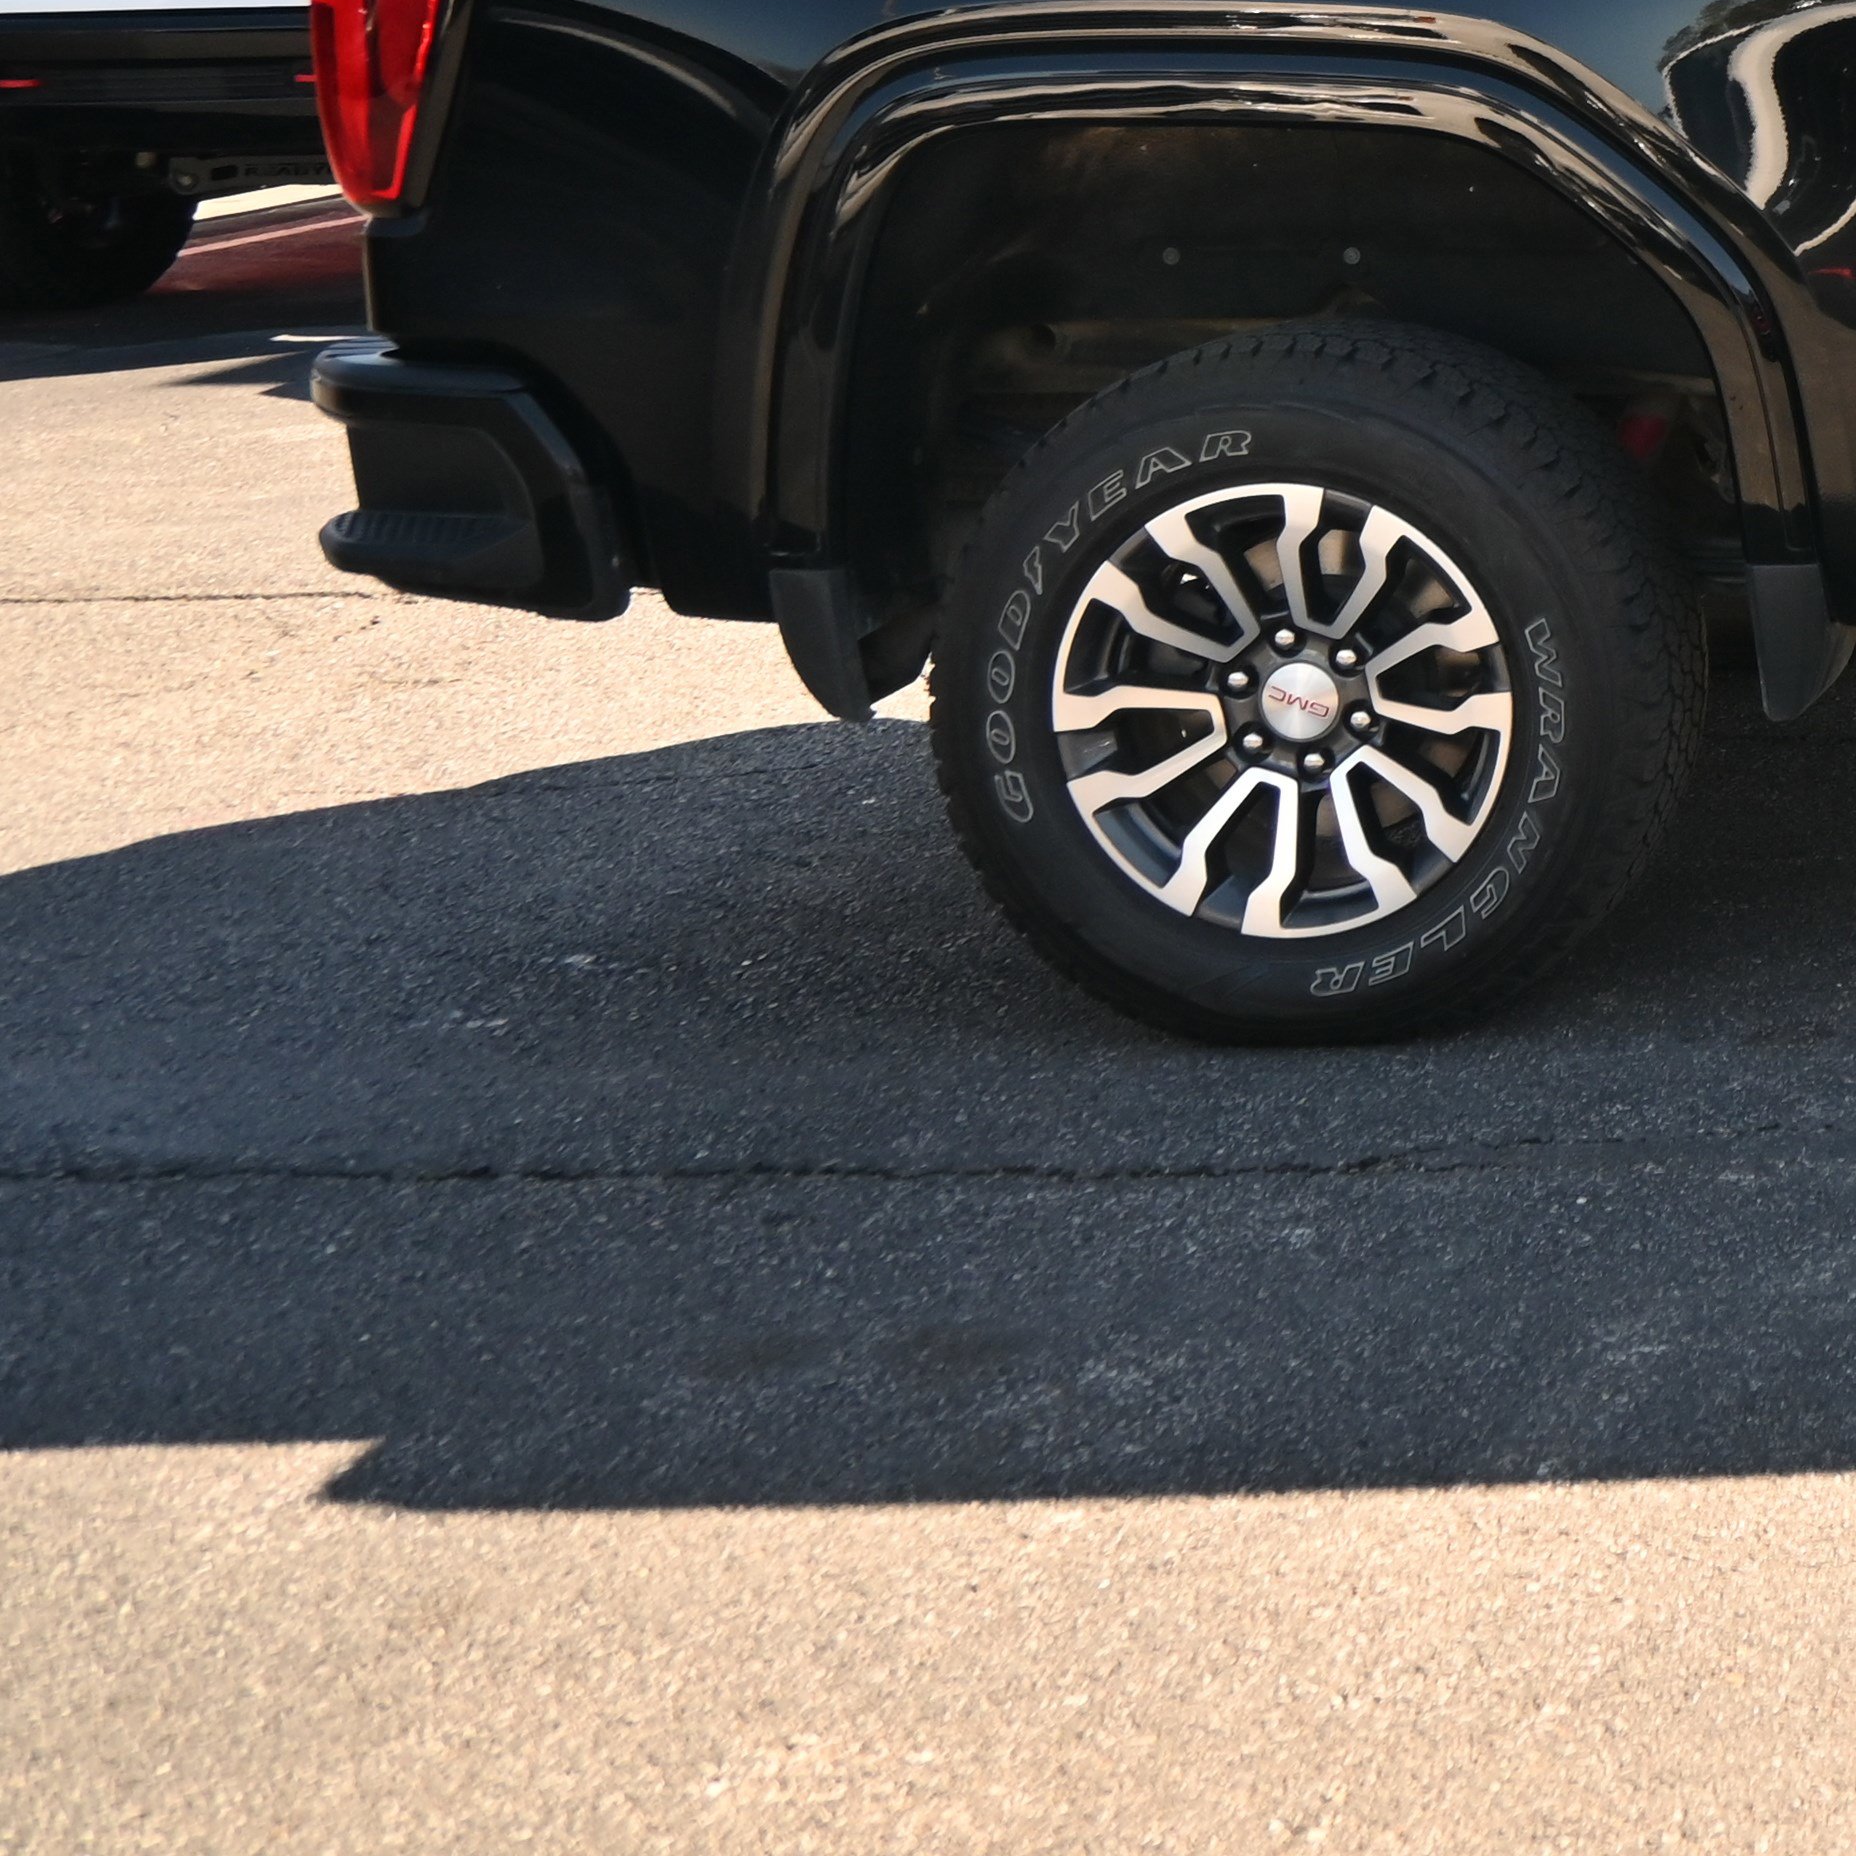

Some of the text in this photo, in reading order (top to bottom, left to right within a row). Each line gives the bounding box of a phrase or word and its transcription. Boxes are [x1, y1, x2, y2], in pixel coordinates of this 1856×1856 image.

[985, 429, 1252, 825] GOODYEAR
[1268, 685, 1330, 718] GMC
[1311, 616, 1566, 997] WRANGLER
